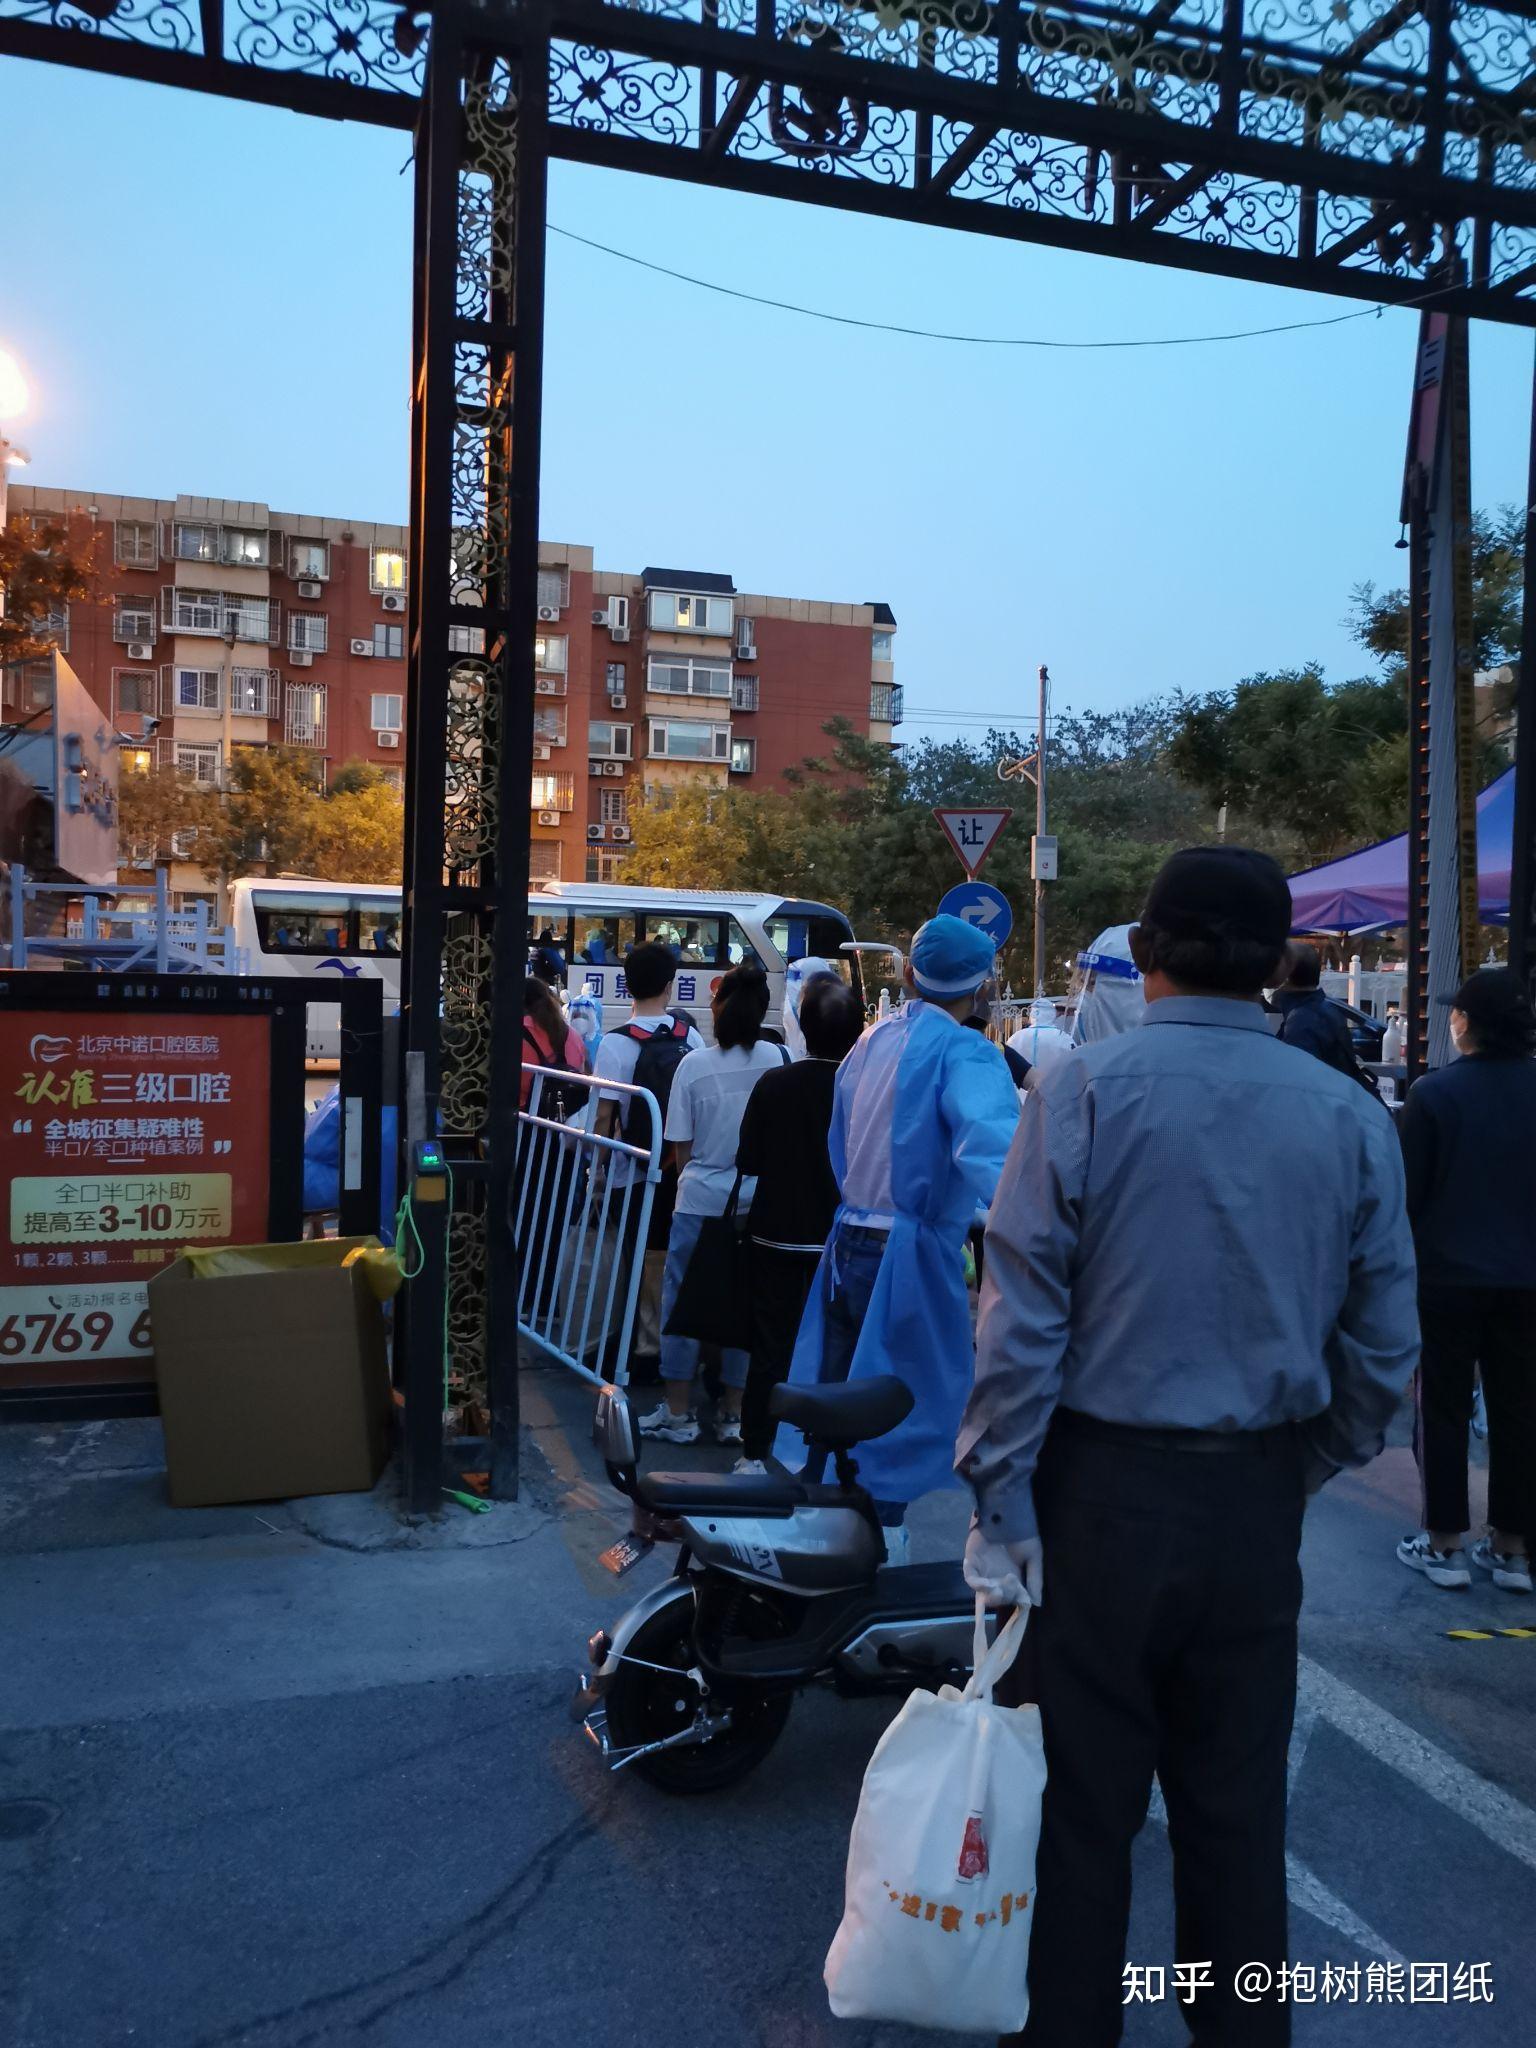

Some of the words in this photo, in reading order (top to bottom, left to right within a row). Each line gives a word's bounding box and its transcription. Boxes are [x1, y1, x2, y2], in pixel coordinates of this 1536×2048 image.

[958, 818, 984, 845] 让
[77, 1035, 220, 1054] 北京中诺口腔医院
[45, 1117, 204, 1140] 全城征集疑难性
[45, 1139, 204, 1157] 半口/全口种植案例
[56, 1181, 192, 1204] 全口半口补助
[24, 1203, 222, 1234] 提高至3-10万元
[0, 1311, 114, 1356] 6769
